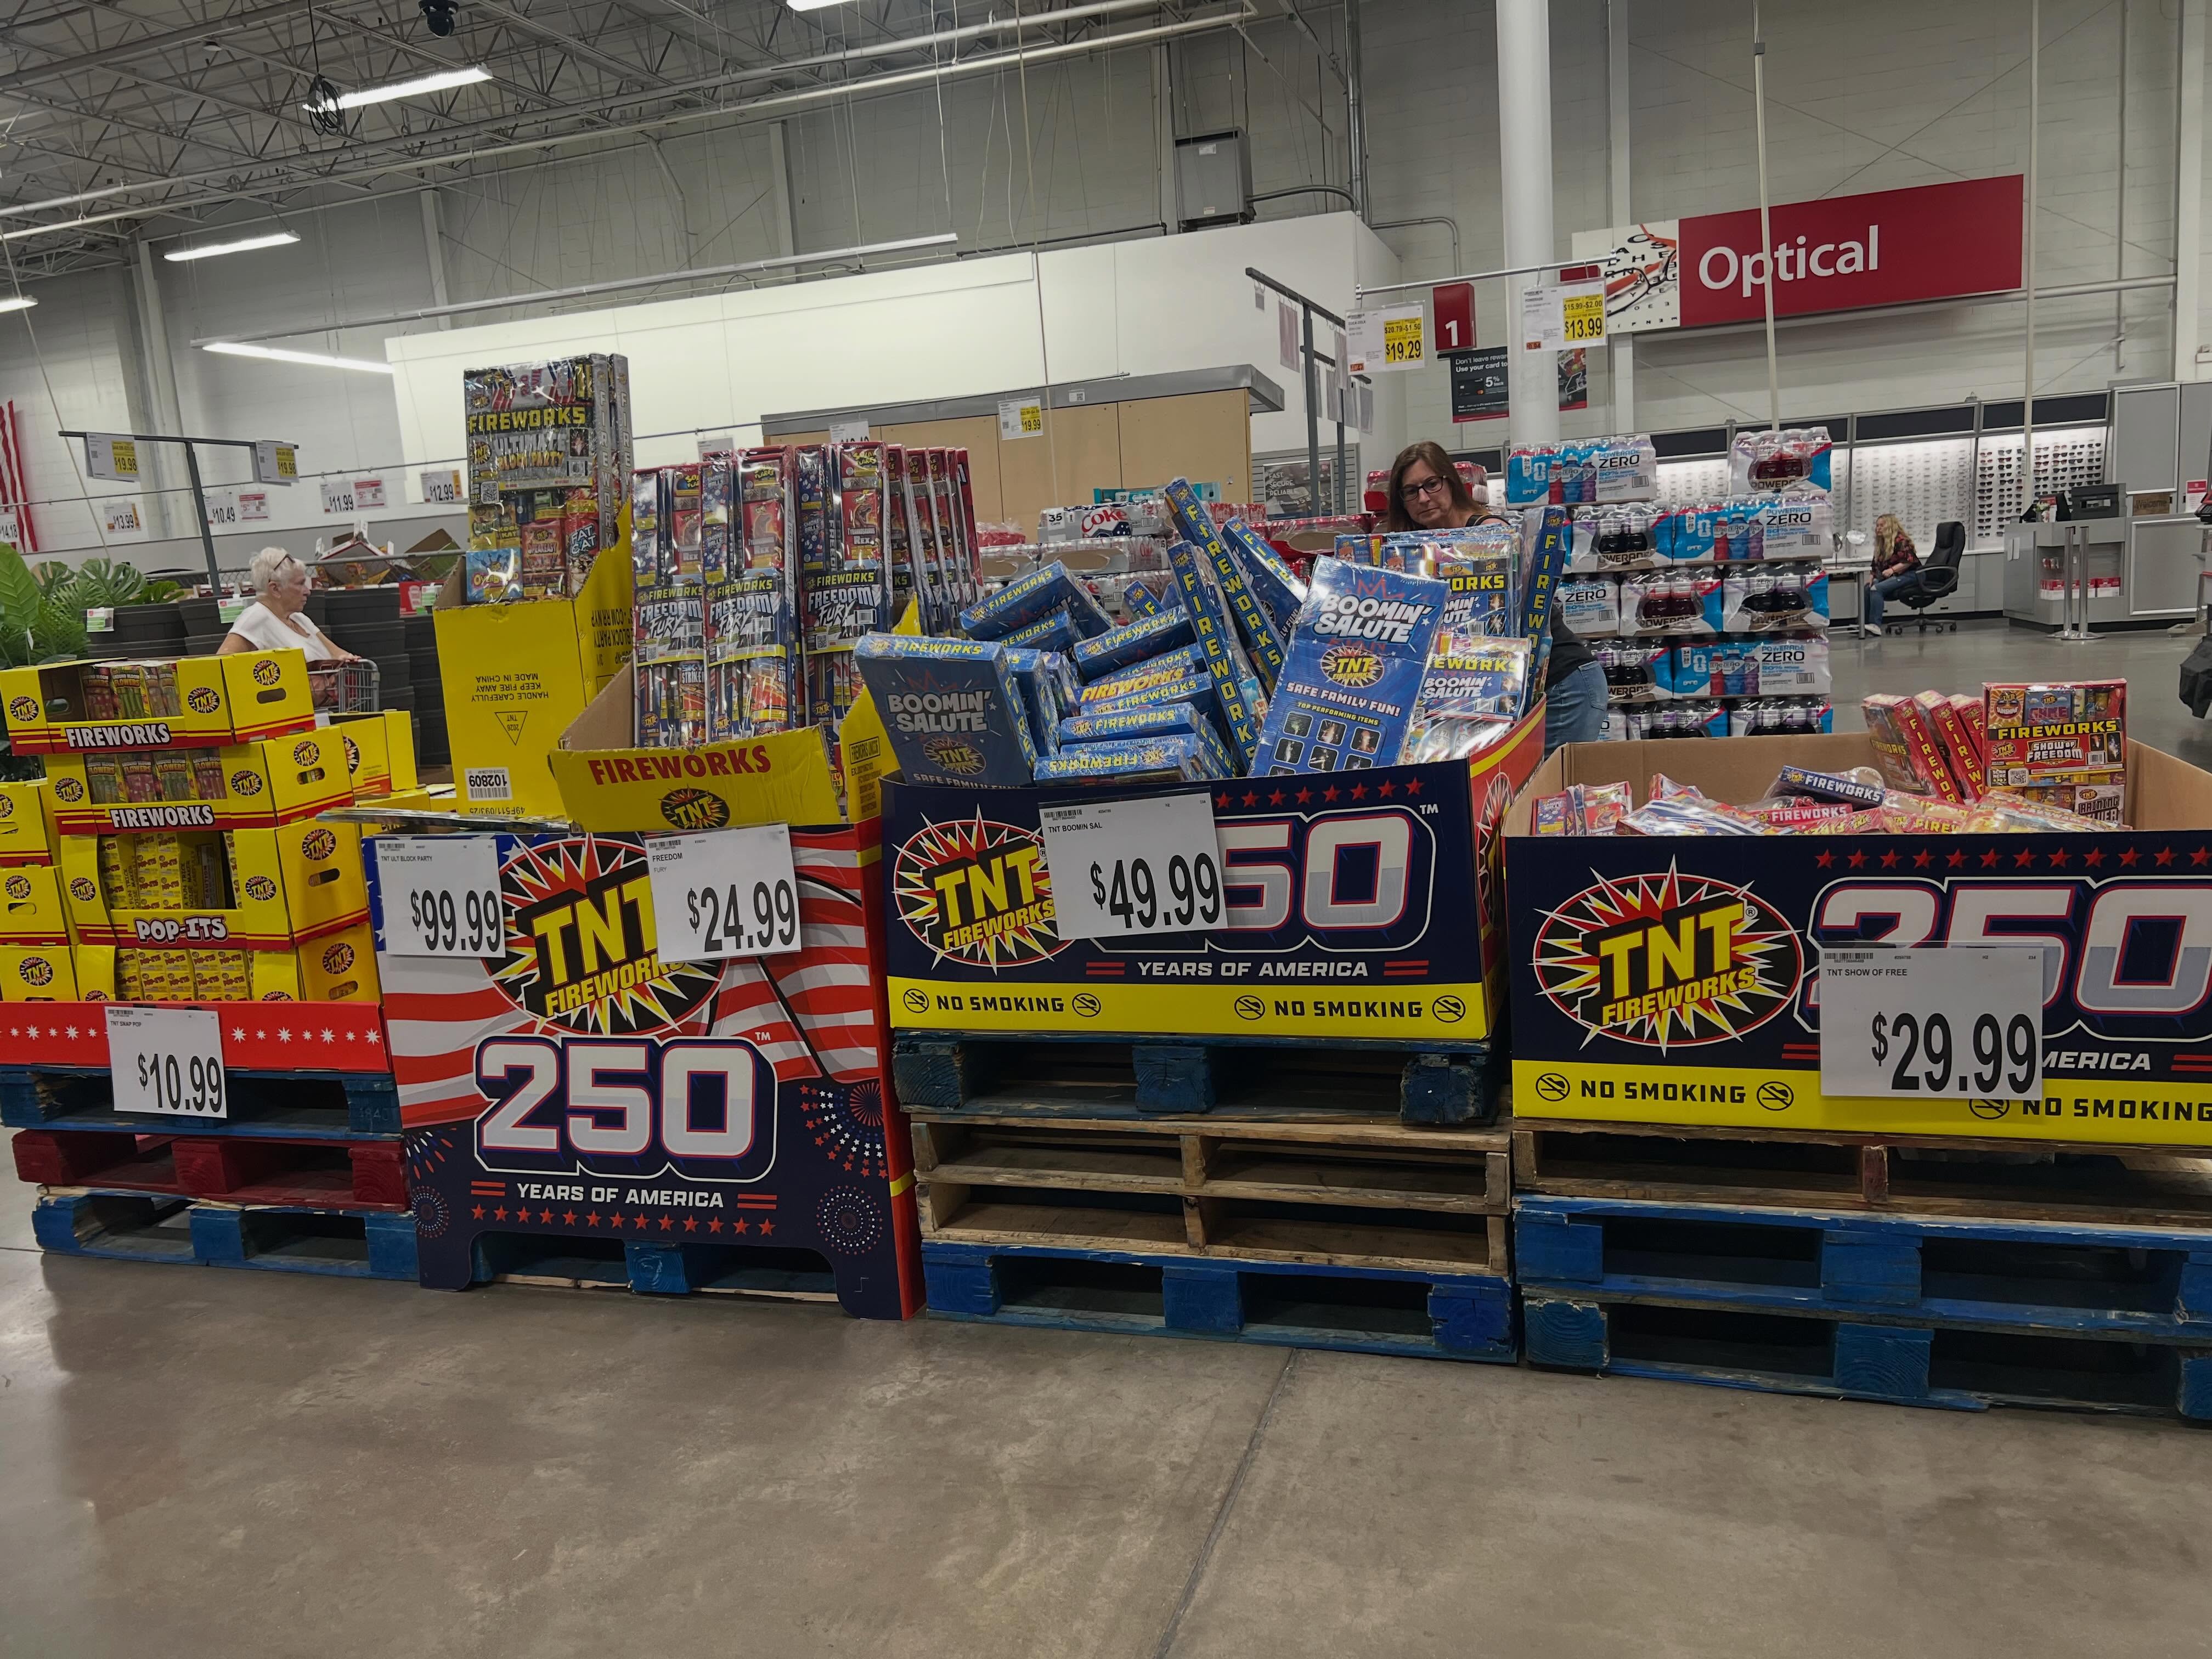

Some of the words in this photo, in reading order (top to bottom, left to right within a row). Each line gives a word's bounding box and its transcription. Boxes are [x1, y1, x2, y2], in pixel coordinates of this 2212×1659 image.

[1699, 224, 1879, 298] Optical
[1445, 320, 1458, 346] 1
[1565, 317, 1602, 338] $13.99
[1385, 340, 1421, 360] $19.29
[469, 407, 585, 433] FIREWORKS
[114, 456, 137, 472] $19.98
[600, 390, 615, 548] FIREWORK
[1598, 454, 1640, 469] ZERO
[430, 483, 454, 502] $12.99
[329, 494, 354, 512] $11.99
[114, 514, 134, 530] $13.99
[212, 506, 235, 524] $10.49
[1048, 513, 1063, 522] 35
[1081, 508, 1127, 533] Coke
[1766, 512, 1812, 526] ZERO
[0, 523, 18, 539] 14.18
[571, 526, 592, 544] FAT
[571, 536, 596, 556] CAT
[717, 579, 773, 598] FIREWORKS
[817, 572, 874, 585] FIREWORKS
[989, 567, 1053, 610] FIREWORKS
[1186, 504, 1282, 668] FIREWORKS
[648, 585, 703, 601] FIREWORKS
[808, 584, 881, 612] FREEDOM
[1565, 589, 1607, 602] ZERO
[639, 599, 702, 625] FREEDOM
[709, 591, 782, 623] FREEDOM
[818, 599, 856, 625] FURY
[1319, 594, 1432, 624] BOOMIN'
[650, 613, 685, 638] FURY
[1105, 611, 1175, 646] FIREWORKS
[1314, 614, 1416, 643] SALUTE
[594, 630, 611, 648] PARTY
[894, 641, 984, 654] FIREWORKS
[1335, 657, 1373, 676] TNT
[1762, 651, 1805, 663] ZERO
[475, 675, 500, 684] CHINA
[515, 673, 538, 681] MADE
[520, 682, 541, 690] KEEP
[1080, 667, 1185, 703] FIREWORKS
[1424, 676, 1492, 688] BOOMIN'
[471, 693, 515, 703] CAREFULLY
[476, 685, 497, 693] AWAY
[517, 691, 549, 700] HANDLE
[1118, 680, 1198, 710] FIREWORKS
[1423, 685, 1482, 699] SALUTE
[15, 701, 33, 717] TNT
[194, 692, 215, 709] TNT
[887, 690, 991, 713] BOOMIN'
[1286, 682, 1318, 697] SAFE
[1320, 687, 1368, 708] FAMILY
[1369, 698, 1401, 718] FUN!
[506, 714, 517, 722] TNT
[896, 712, 988, 733] SALUTE
[1095, 710, 1176, 731] FIREWORKS
[1297, 701, 1311, 711] TOP
[1311, 704, 1356, 721] PERFORMING
[1357, 712, 1379, 726] ITEMS
[65, 724, 171, 748] FIREWORKS
[1998, 720, 2118, 740] FIREWORKS
[940, 747, 969, 764] TNT
[2026, 749, 2083, 763] FREEDOM
[2033, 741, 2064, 751] SHOW
[588, 744, 772, 786] FIREWORKS
[1048, 753, 1138, 772] FIREWORKS
[1909, 718, 1957, 804] FIREWOR
[469, 774, 507, 787] 102809
[913, 773, 937, 785] SAFE
[1804, 775, 1881, 803] FIREWORKS
[60, 783, 77, 798] TNT
[110, 805, 214, 828] FIREWORKS
[675, 795, 713, 827] TNT
[1771, 806, 1847, 822] FIREWORKS
[1048, 825, 1061, 833] TNT
[1062, 822, 1088, 832] BOOMIN
[1089, 821, 1103, 830] SAL
[652, 853, 683, 862] FREEDOM
[1215, 815, 1410, 929] 50
[934, 844, 1040, 929] TNT
[1090, 852, 1221, 929] $49.99
[410, 888, 501, 952] $99.99
[686, 879, 797, 953] $24.99
[943, 899, 1056, 951] FIREWORKS
[136, 916, 228, 942] POP-ITS
[532, 874, 658, 987] TNT
[1599, 902, 1745, 1002] TNT
[1137, 961, 1212, 977] YEARS
[1220, 961, 1252, 977] OF
[1258, 961, 1368, 977] AMERICA
[1827, 968, 1843, 977] TNT
[1844, 968, 1870, 977] SHOW
[1871, 968, 1883, 977] OF
[1886, 968, 1908, 977] FREE
[936, 995, 963, 1011] NO
[970, 996, 1065, 1012] SMOKING
[1601, 966, 1756, 1026] FIREWORKS
[1274, 1000, 1306, 1016] NO
[1313, 1001, 1423, 1018] SMOKING
[1871, 1011, 2037, 1094] $29.99
[2041, 1052, 2152, 1071] MERICA
[138, 1052, 223, 1113] $10.99
[1580, 1079, 1615, 1099] NO
[1624, 1082, 1746, 1104] SMOKING
[480, 1042, 757, 1159] 250
[2022, 1098, 2062, 1116] NO
[2073, 1098, 2212, 1122] SMOKING
[516, 1182, 585, 1202] YEARS
[591, 1186, 618, 1204] OF
[625, 1188, 724, 1209] AMERICA
